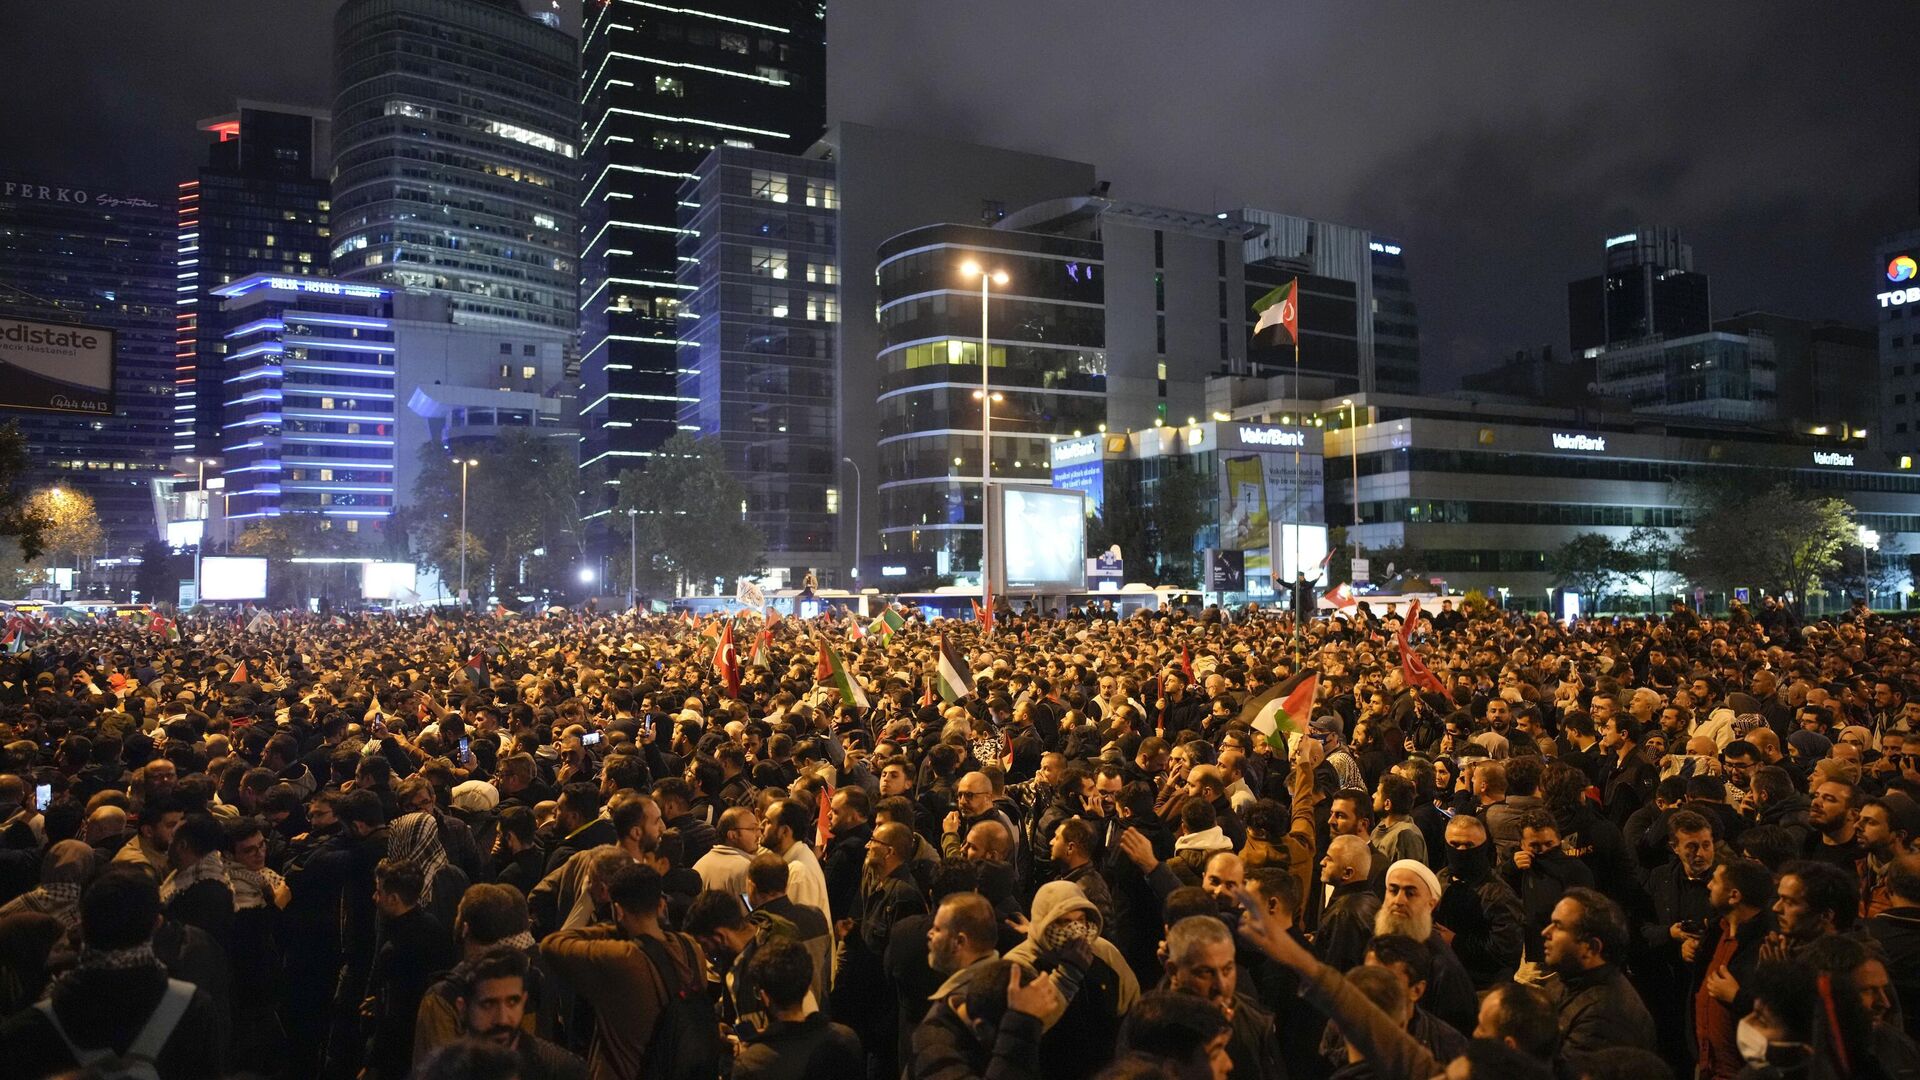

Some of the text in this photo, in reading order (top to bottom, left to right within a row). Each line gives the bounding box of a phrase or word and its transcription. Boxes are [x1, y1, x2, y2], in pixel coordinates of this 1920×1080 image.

[5, 182, 88, 204] FERKO
[271, 279, 298, 290] DELTA
[305, 282, 340, 294] HOTELS
[0, 324, 97, 349] distate
